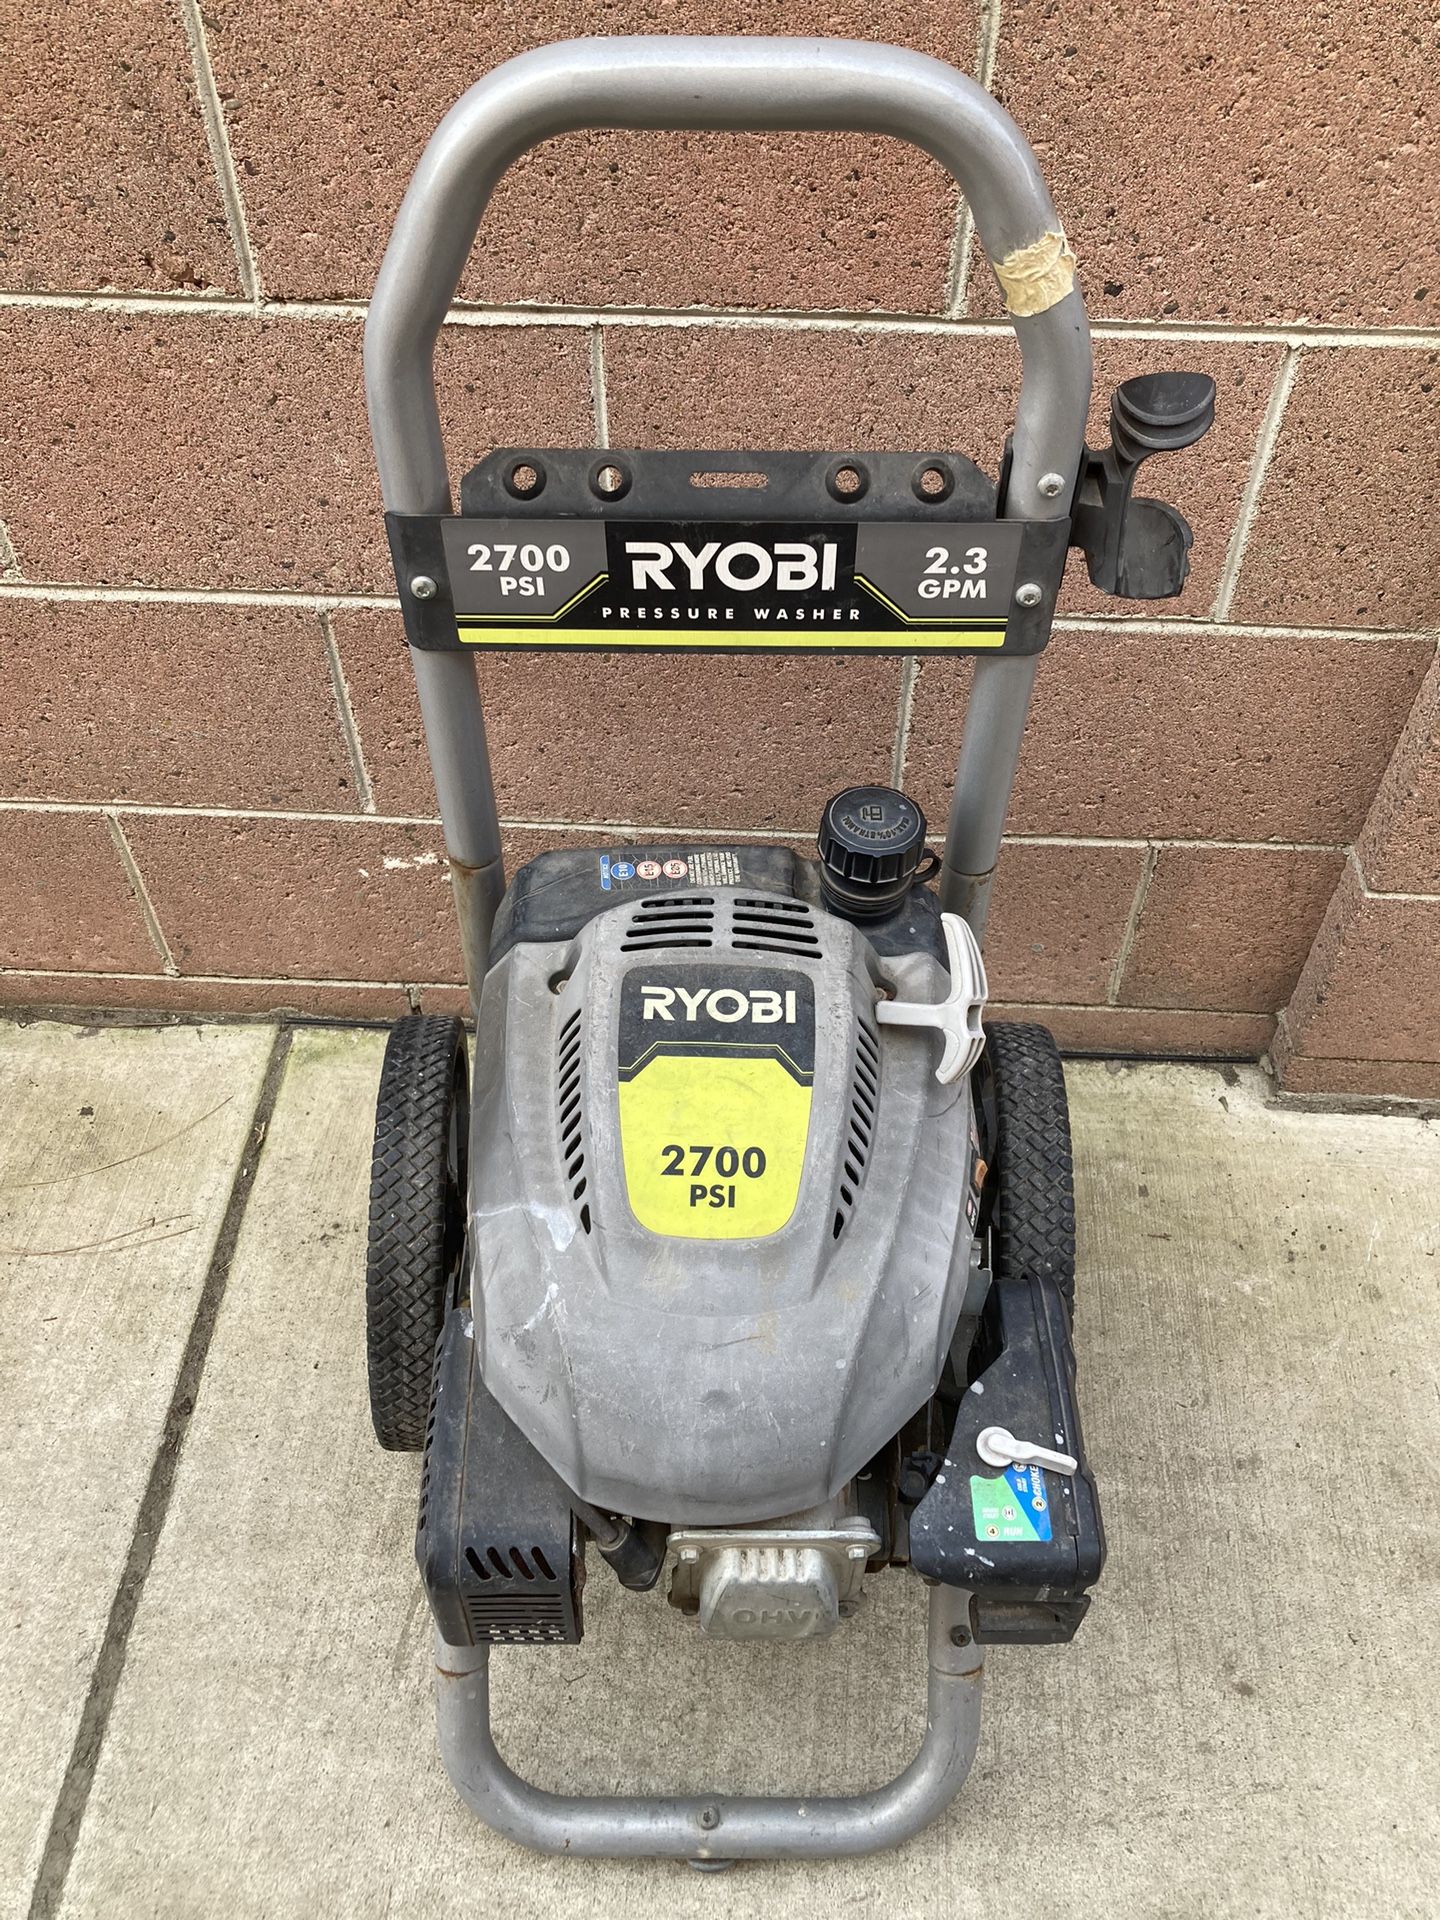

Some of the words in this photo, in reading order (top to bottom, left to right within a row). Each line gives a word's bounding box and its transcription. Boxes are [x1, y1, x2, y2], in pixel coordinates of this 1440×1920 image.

[467, 544, 570, 572] 2700
[625, 542, 838, 591] RYOBI
[923, 547, 988, 575] 2.3
[500, 577, 545, 596] PSI
[917, 579, 987, 599] GPM
[602, 607, 734, 619] PRESSURE
[754, 608, 860, 620] WASHER
[618, 864, 628, 877] E10
[641, 986, 796, 1023] RYOBI
[660, 1144, 767, 1178] 2700
[690, 1184, 735, 1208] PSI
[1029, 1464, 1043, 1496] CHOKE
[732, 1608, 811, 1625] OHV
